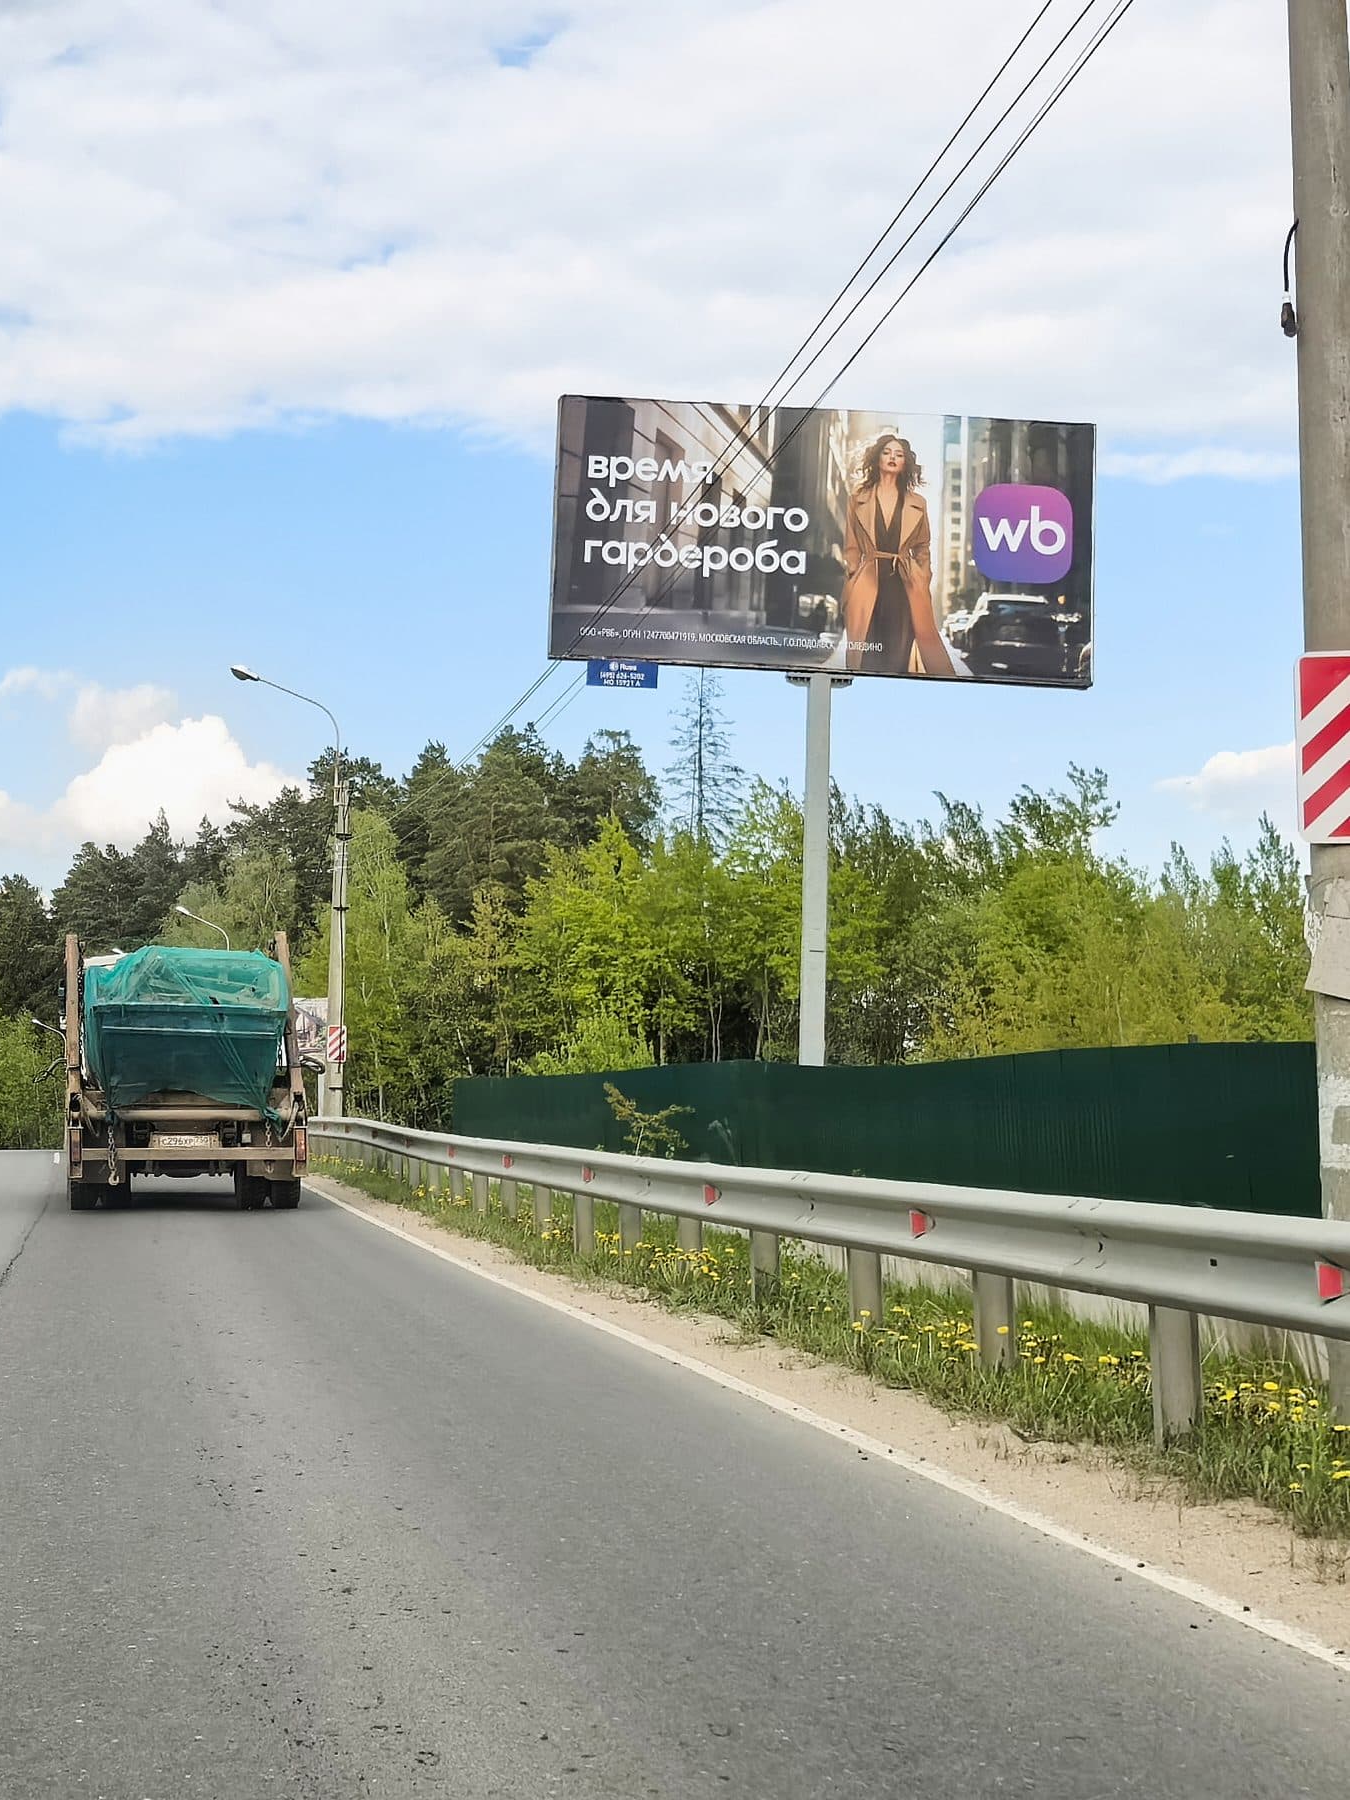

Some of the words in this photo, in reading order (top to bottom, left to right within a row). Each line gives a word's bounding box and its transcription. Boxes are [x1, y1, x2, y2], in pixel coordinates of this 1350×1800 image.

[586, 455, 715, 488] время
[585, 487, 657, 524] для
[670, 500, 810, 533] нового
[978, 505, 1066, 555] wb
[583, 532, 807, 578] гардероба
[698, 632, 746, 645] МОСКОВСКАЯ
